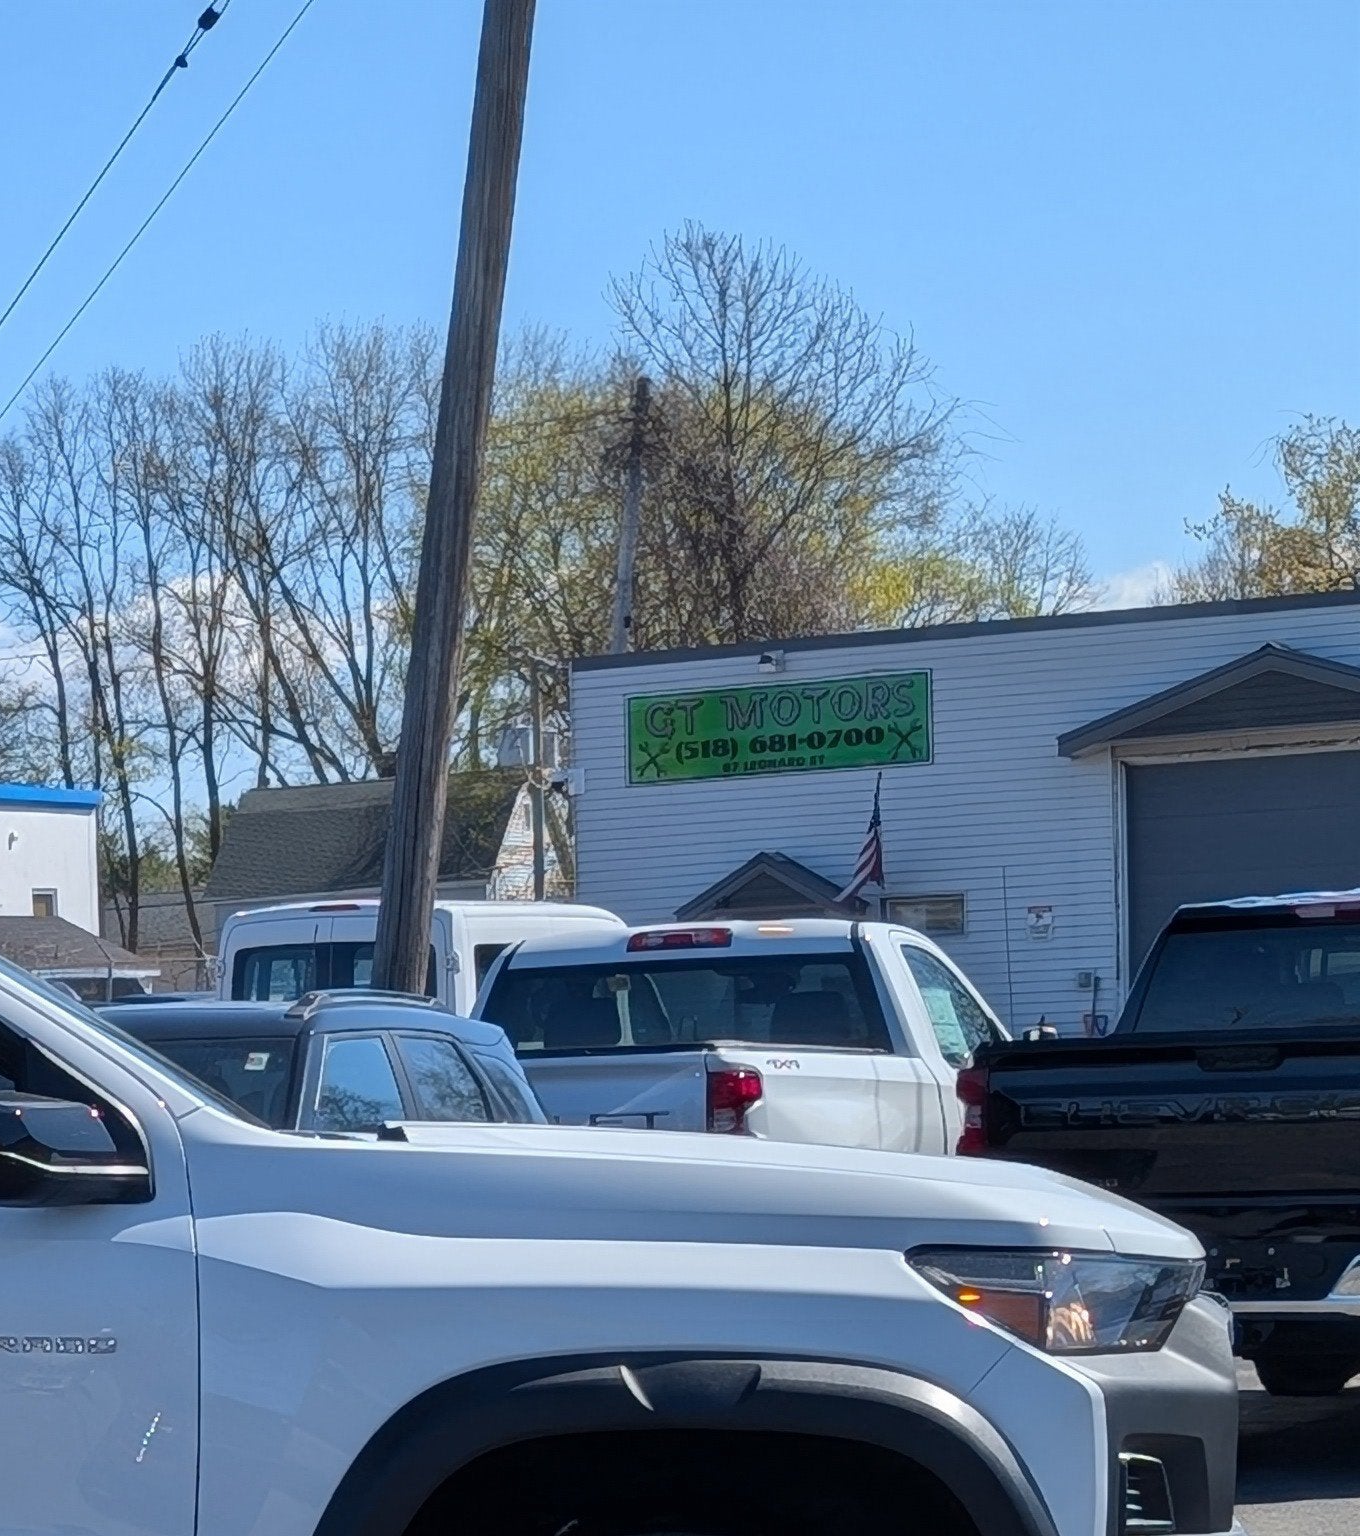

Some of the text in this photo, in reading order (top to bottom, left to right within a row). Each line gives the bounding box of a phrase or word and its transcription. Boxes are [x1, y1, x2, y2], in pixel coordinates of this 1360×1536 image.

[644, 678, 917, 740] GT MOTORS
[675, 726, 885, 766] (518) 681-0700
